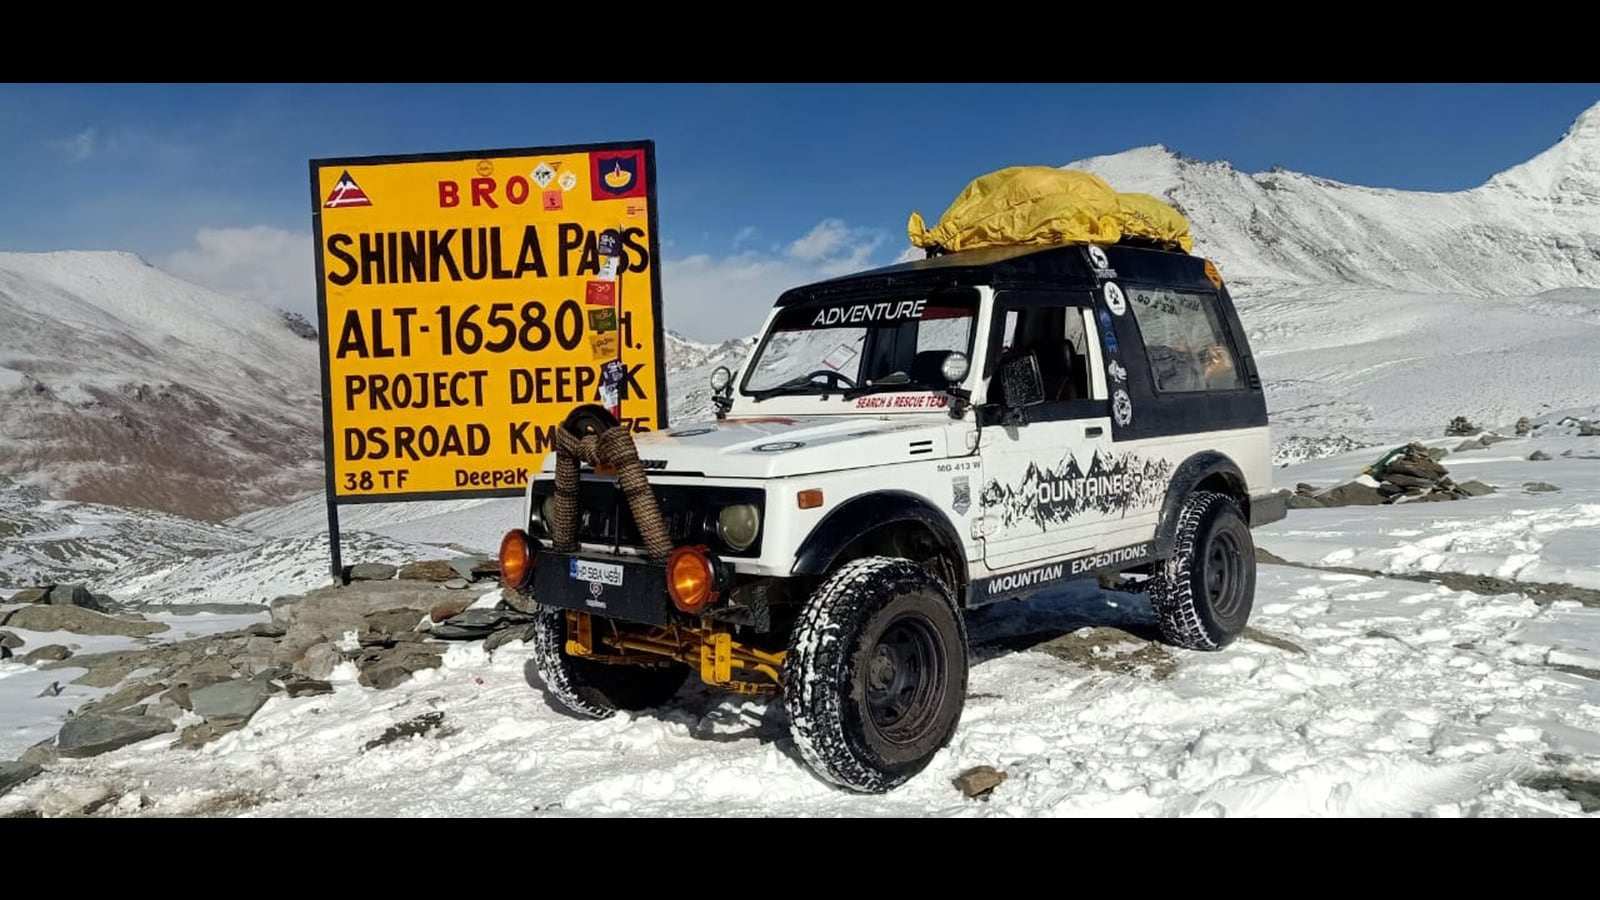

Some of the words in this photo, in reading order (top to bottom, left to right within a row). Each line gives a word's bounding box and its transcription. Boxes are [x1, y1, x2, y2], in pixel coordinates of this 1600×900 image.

[438, 176, 529, 208] BRO
[327, 224, 547, 286] SHINKULA
[336, 299, 584, 359] ALT-16580
[812, 300, 928, 326] ADVENTURE
[345, 370, 488, 411] PROJECT
[856, 397, 886, 408] SEARCH
[887, 397, 893, 407] &
[894, 396, 925, 408] RESCUE
[926, 395, 948, 407] TEAM
[455, 468, 529, 487] Deepak
[988, 566, 1062, 594] MOUNTIAN
[1071, 544, 1148, 574] EXPEDITIONS
